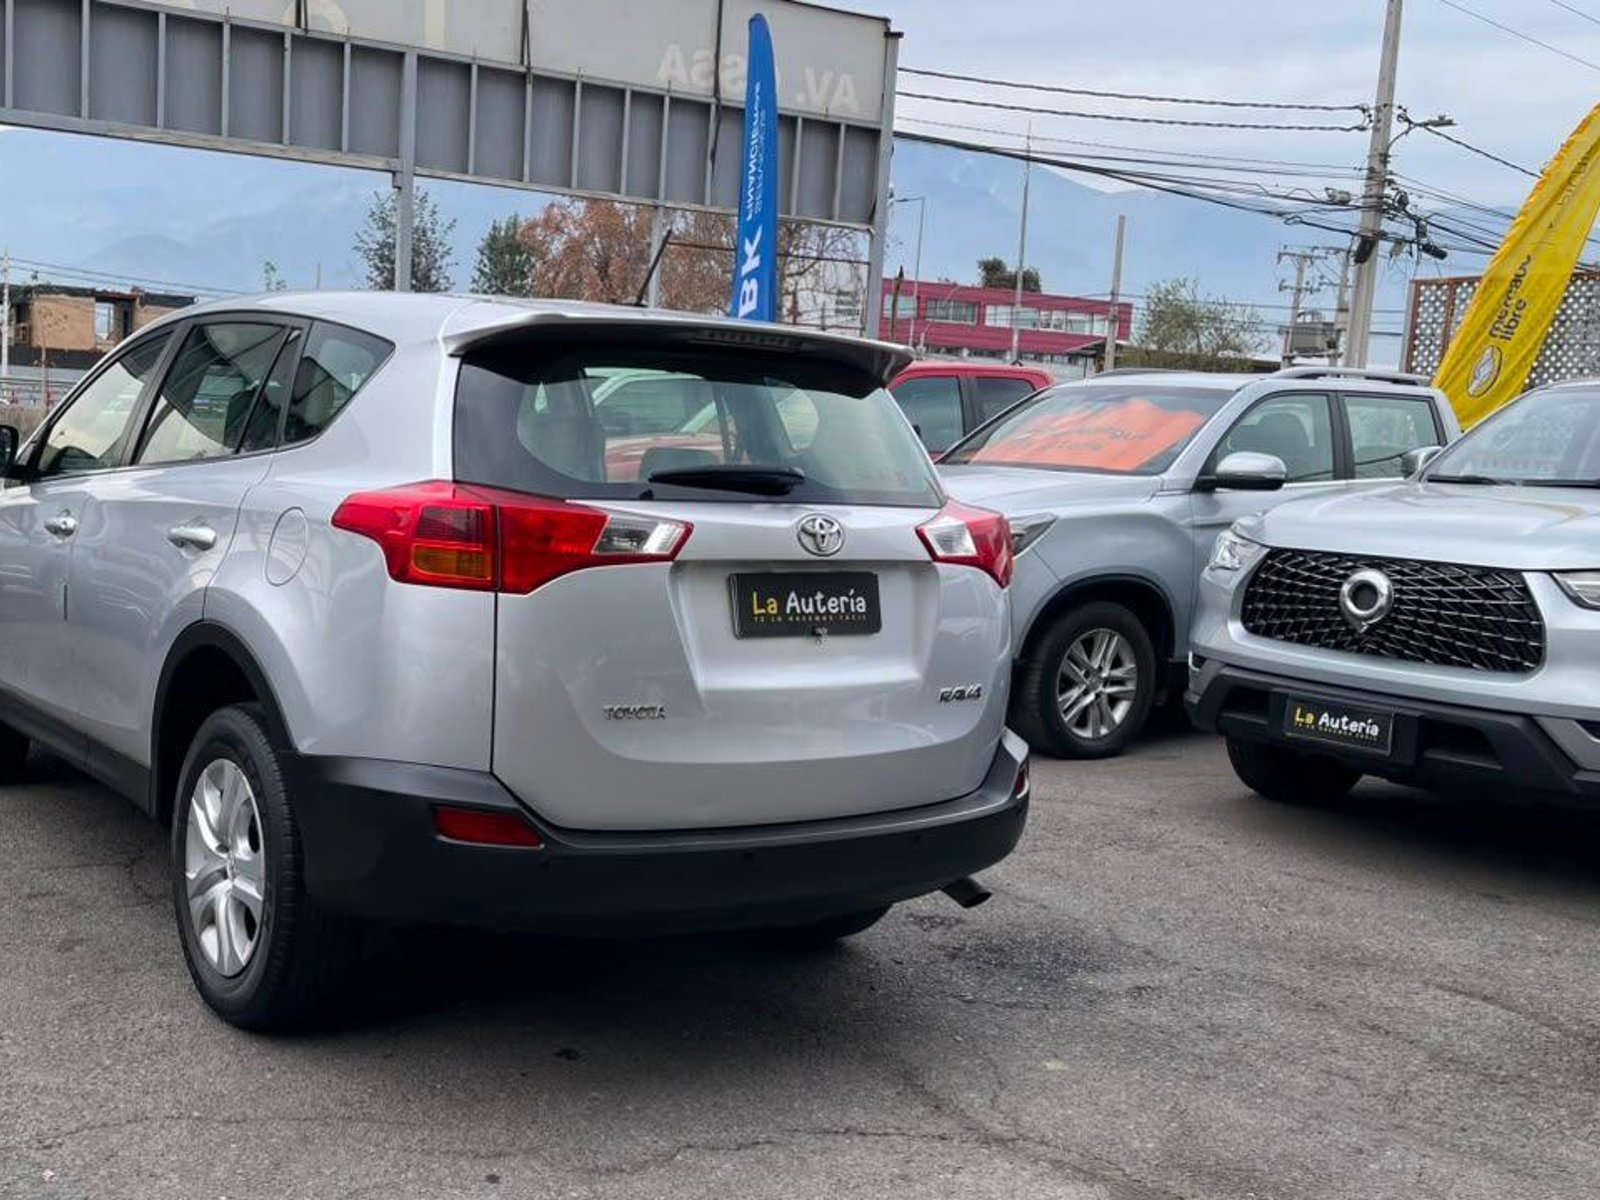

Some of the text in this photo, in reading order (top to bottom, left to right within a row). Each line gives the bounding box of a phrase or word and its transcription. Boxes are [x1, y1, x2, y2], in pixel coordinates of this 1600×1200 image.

[738, 224, 762, 319] BK
[1499, 299, 1527, 341] libre
[752, 589, 867, 615] La Autería
[602, 704, 668, 720] TOYOTA
[1295, 707, 1315, 725] La
